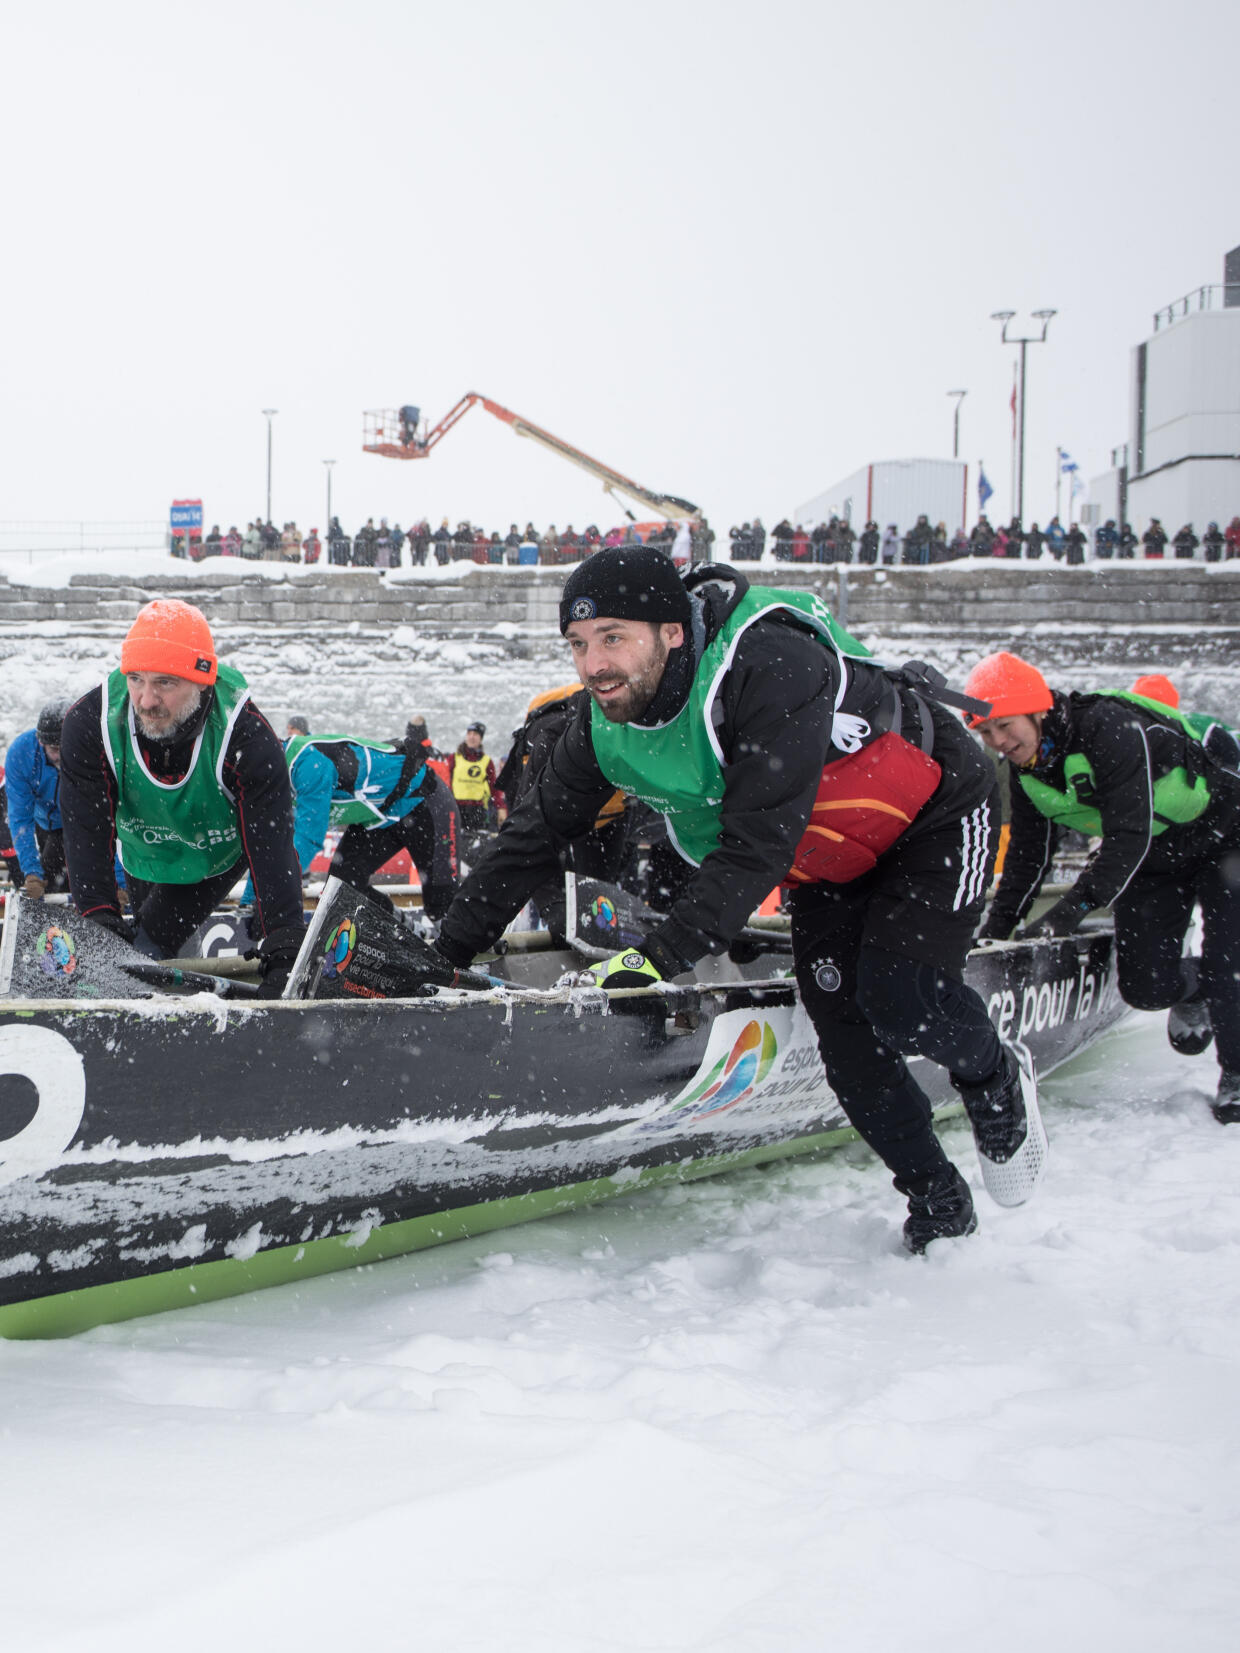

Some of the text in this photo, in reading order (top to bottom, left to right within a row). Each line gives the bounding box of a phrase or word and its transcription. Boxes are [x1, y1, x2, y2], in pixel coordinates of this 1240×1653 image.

[358, 942, 386, 961] espace
[1017, 977, 1075, 1042] pour
[1074, 965, 1095, 1021] la
